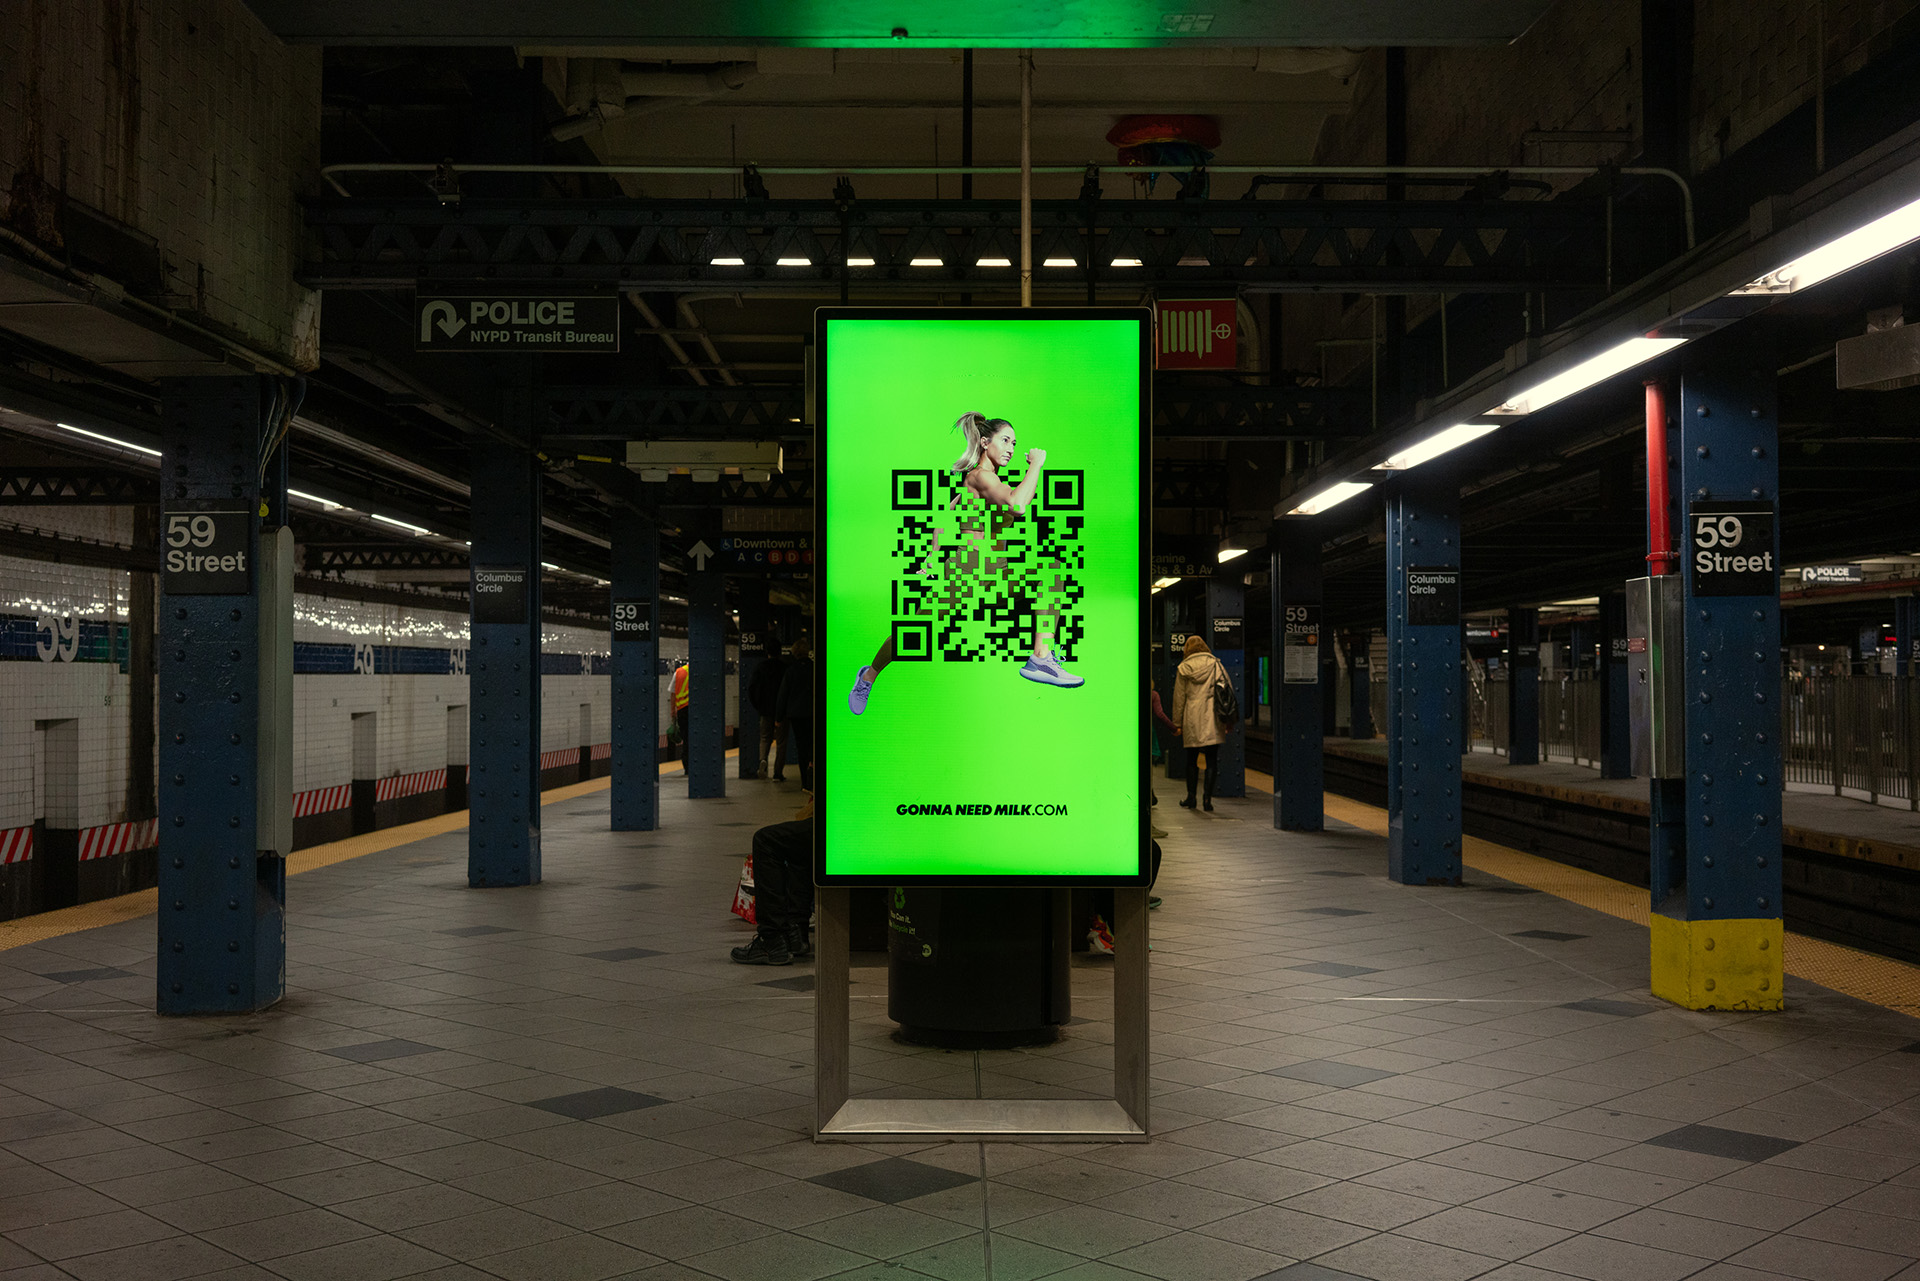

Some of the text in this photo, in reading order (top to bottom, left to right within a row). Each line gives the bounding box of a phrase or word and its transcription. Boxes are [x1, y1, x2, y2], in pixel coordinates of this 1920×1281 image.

[470, 301, 575, 325] POLICE
[470, 330, 614, 343] NYPD Transit Bureau
[166, 515, 216, 548] 59
[1695, 516, 1743, 549] 59
[733, 537, 808, 549] Downtown &
[166, 550, 246, 573] Street
[737, 552, 746, 562] A
[754, 552, 763, 562] C
[1695, 551, 1773, 574] Street
[1172, 565, 1182, 575] &
[1186, 565, 1195, 575] 8
[1199, 565, 1214, 575] Av
[1817, 567, 1850, 576] POLICE
[475, 572, 524, 583] Columbus
[1409, 574, 1457, 584] Columbus
[475, 583, 504, 593] Circle
[1409, 584, 1437, 595] Circle
[614, 604, 638, 620] 59
[1285, 607, 1308, 622] 59
[614, 620, 650, 632] Street
[1213, 619, 1242, 627] Columbus
[1285, 622, 1320, 633] Street
[36, 616, 80, 663] 59
[741, 633, 756, 644] 59
[1170, 634, 1186, 645] 59
[741, 643, 764, 651] Street
[1612, 639, 1627, 650] 59
[896, 804, 1068, 816] GONNA NEED MILK.COM
